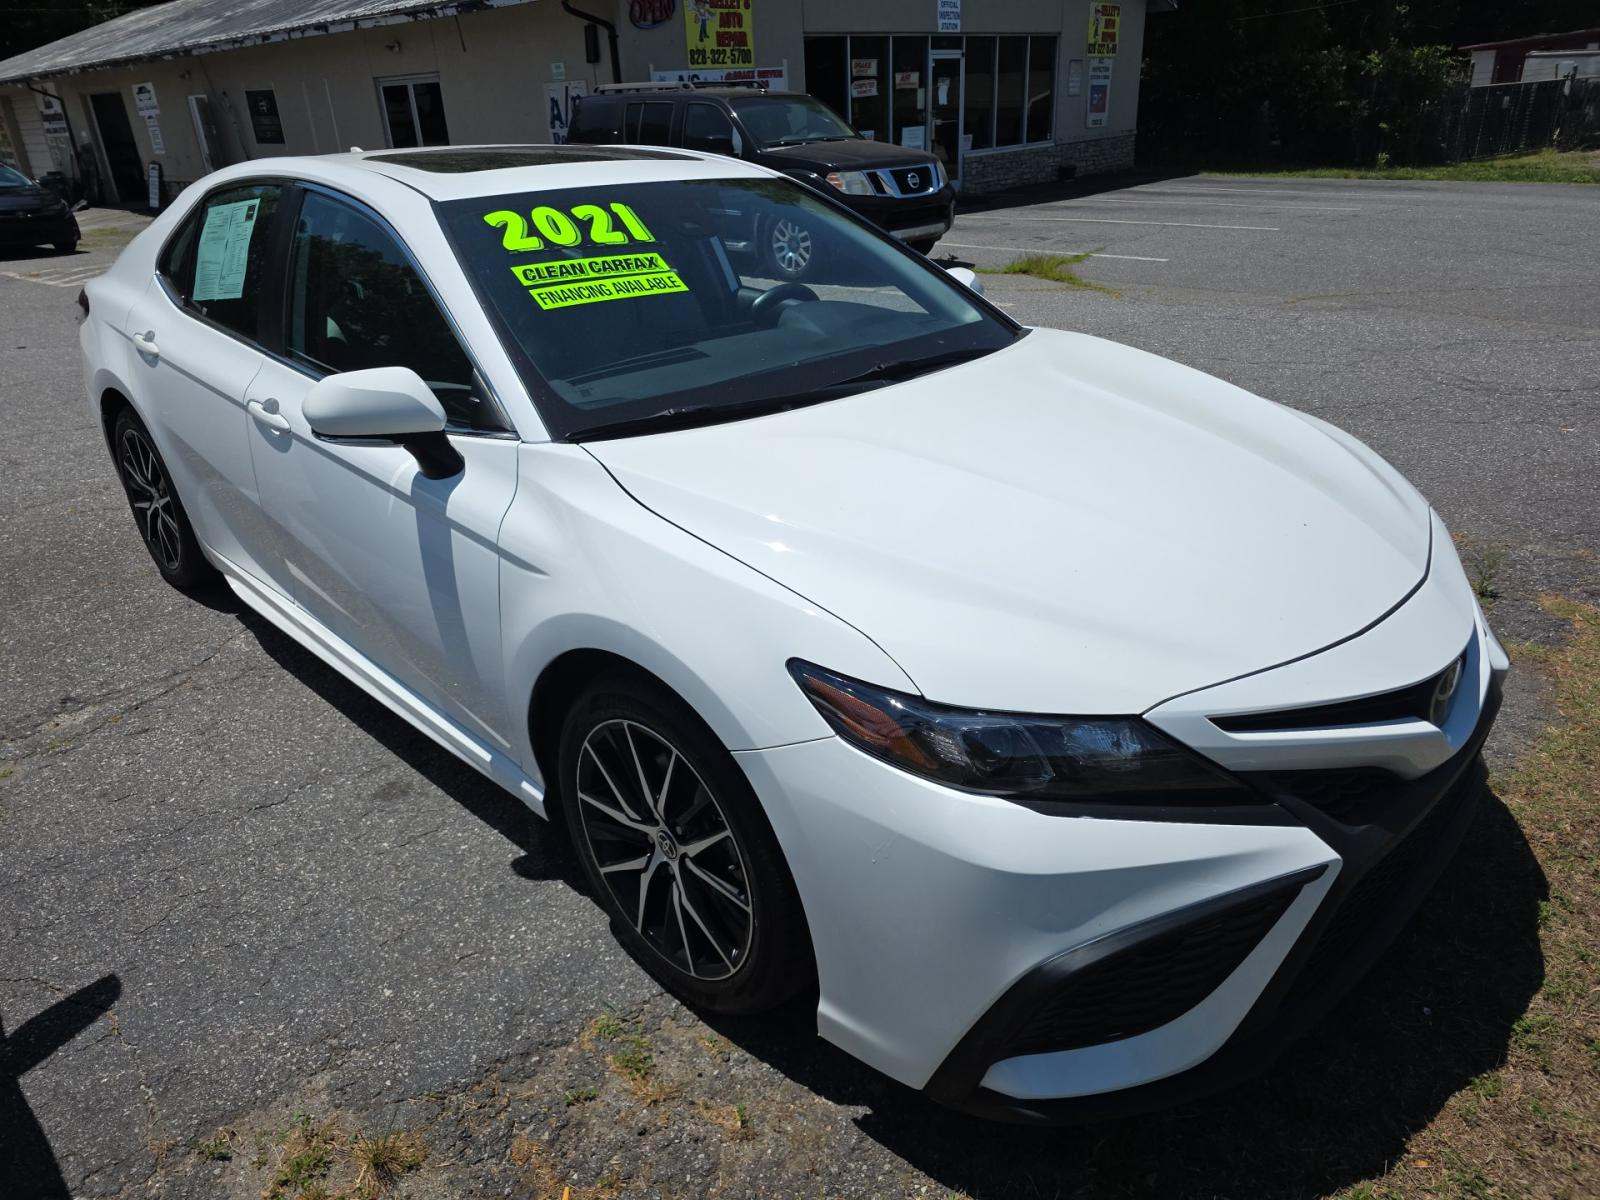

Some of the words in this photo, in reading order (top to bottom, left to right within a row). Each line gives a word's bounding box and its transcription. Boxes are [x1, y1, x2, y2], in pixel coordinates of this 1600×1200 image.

[719, 12, 743, 28] AUTO
[689, 48, 752, 65] 828-322-5700
[483, 202, 656, 251] 2021
[522, 262, 587, 282] CLEAN
[588, 255, 659, 273] CARFAX
[536, 283, 612, 306] FINANCING
[613, 275, 681, 296] AVAILABLE
